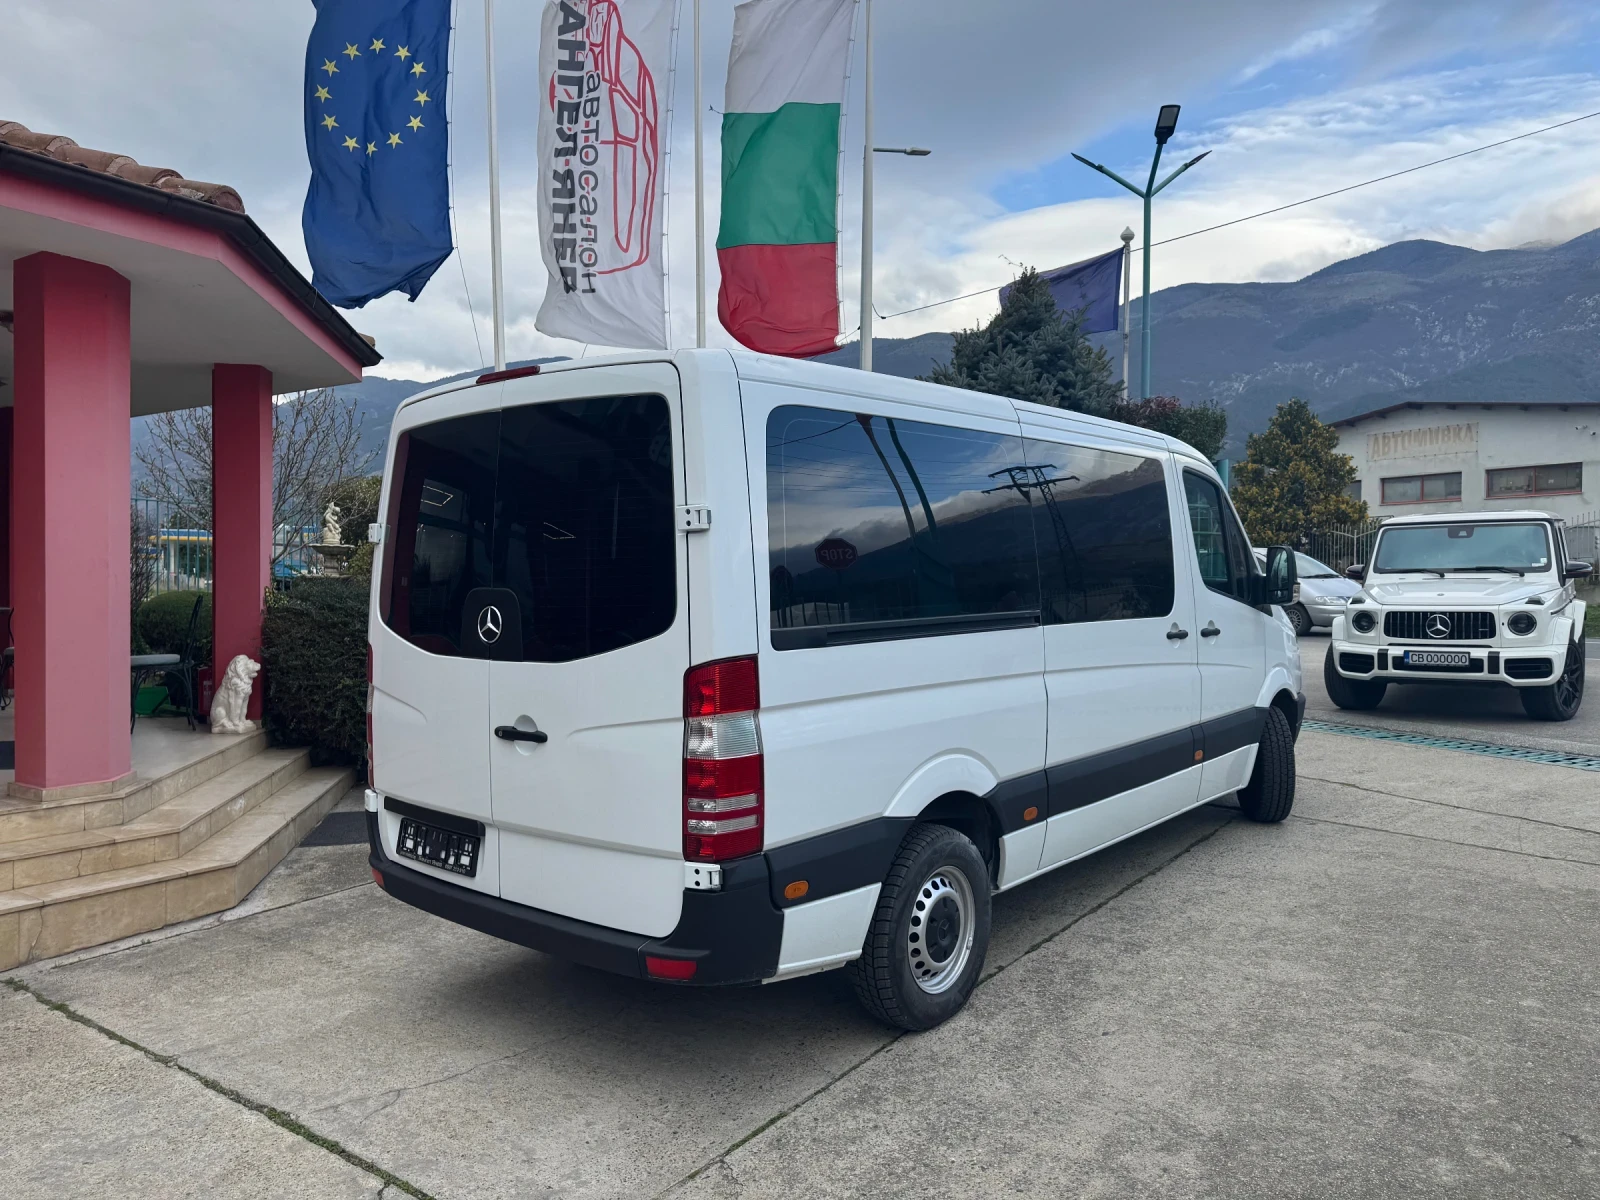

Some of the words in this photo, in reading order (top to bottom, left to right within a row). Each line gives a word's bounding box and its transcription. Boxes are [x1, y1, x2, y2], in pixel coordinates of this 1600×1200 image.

[554, 0, 587, 158] АНГЕЛ
[578, 72, 601, 294] автосалон
[1373, 425, 1473, 458] АВТОМИВКА
